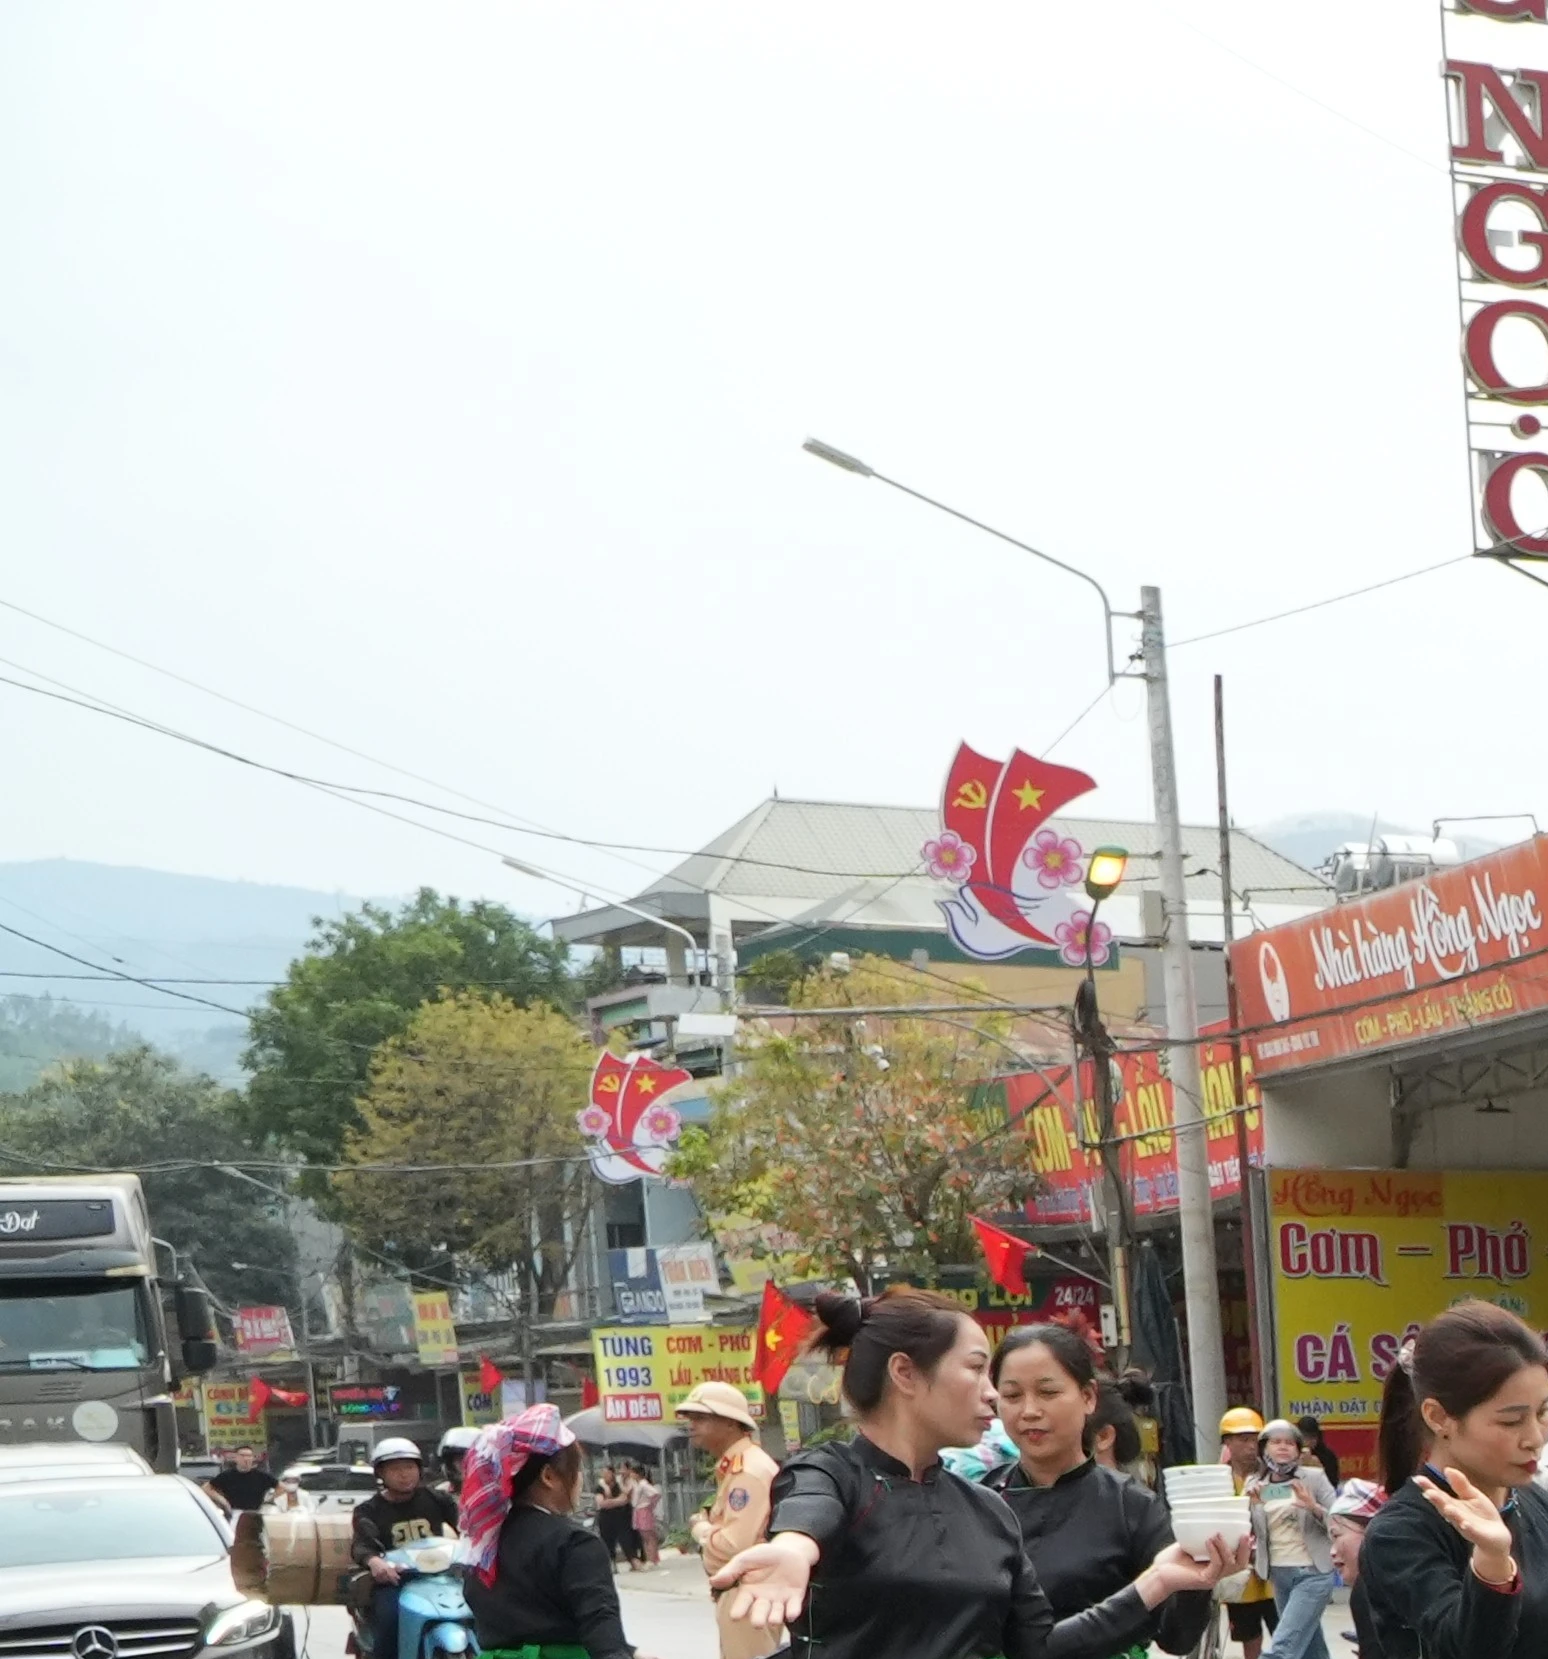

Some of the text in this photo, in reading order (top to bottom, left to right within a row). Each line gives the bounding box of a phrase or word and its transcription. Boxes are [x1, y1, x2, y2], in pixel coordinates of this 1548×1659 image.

[1310, 871, 1541, 990] Nhà hàng Hồng Ngọc
[1278, 1221, 1390, 1287] Cơm
[1443, 1218, 1531, 1288] Phở
[600, 1331, 652, 1357] TÙNG
[1296, 1323, 1359, 1382] CÁ
[603, 1366, 652, 1388] 1993
